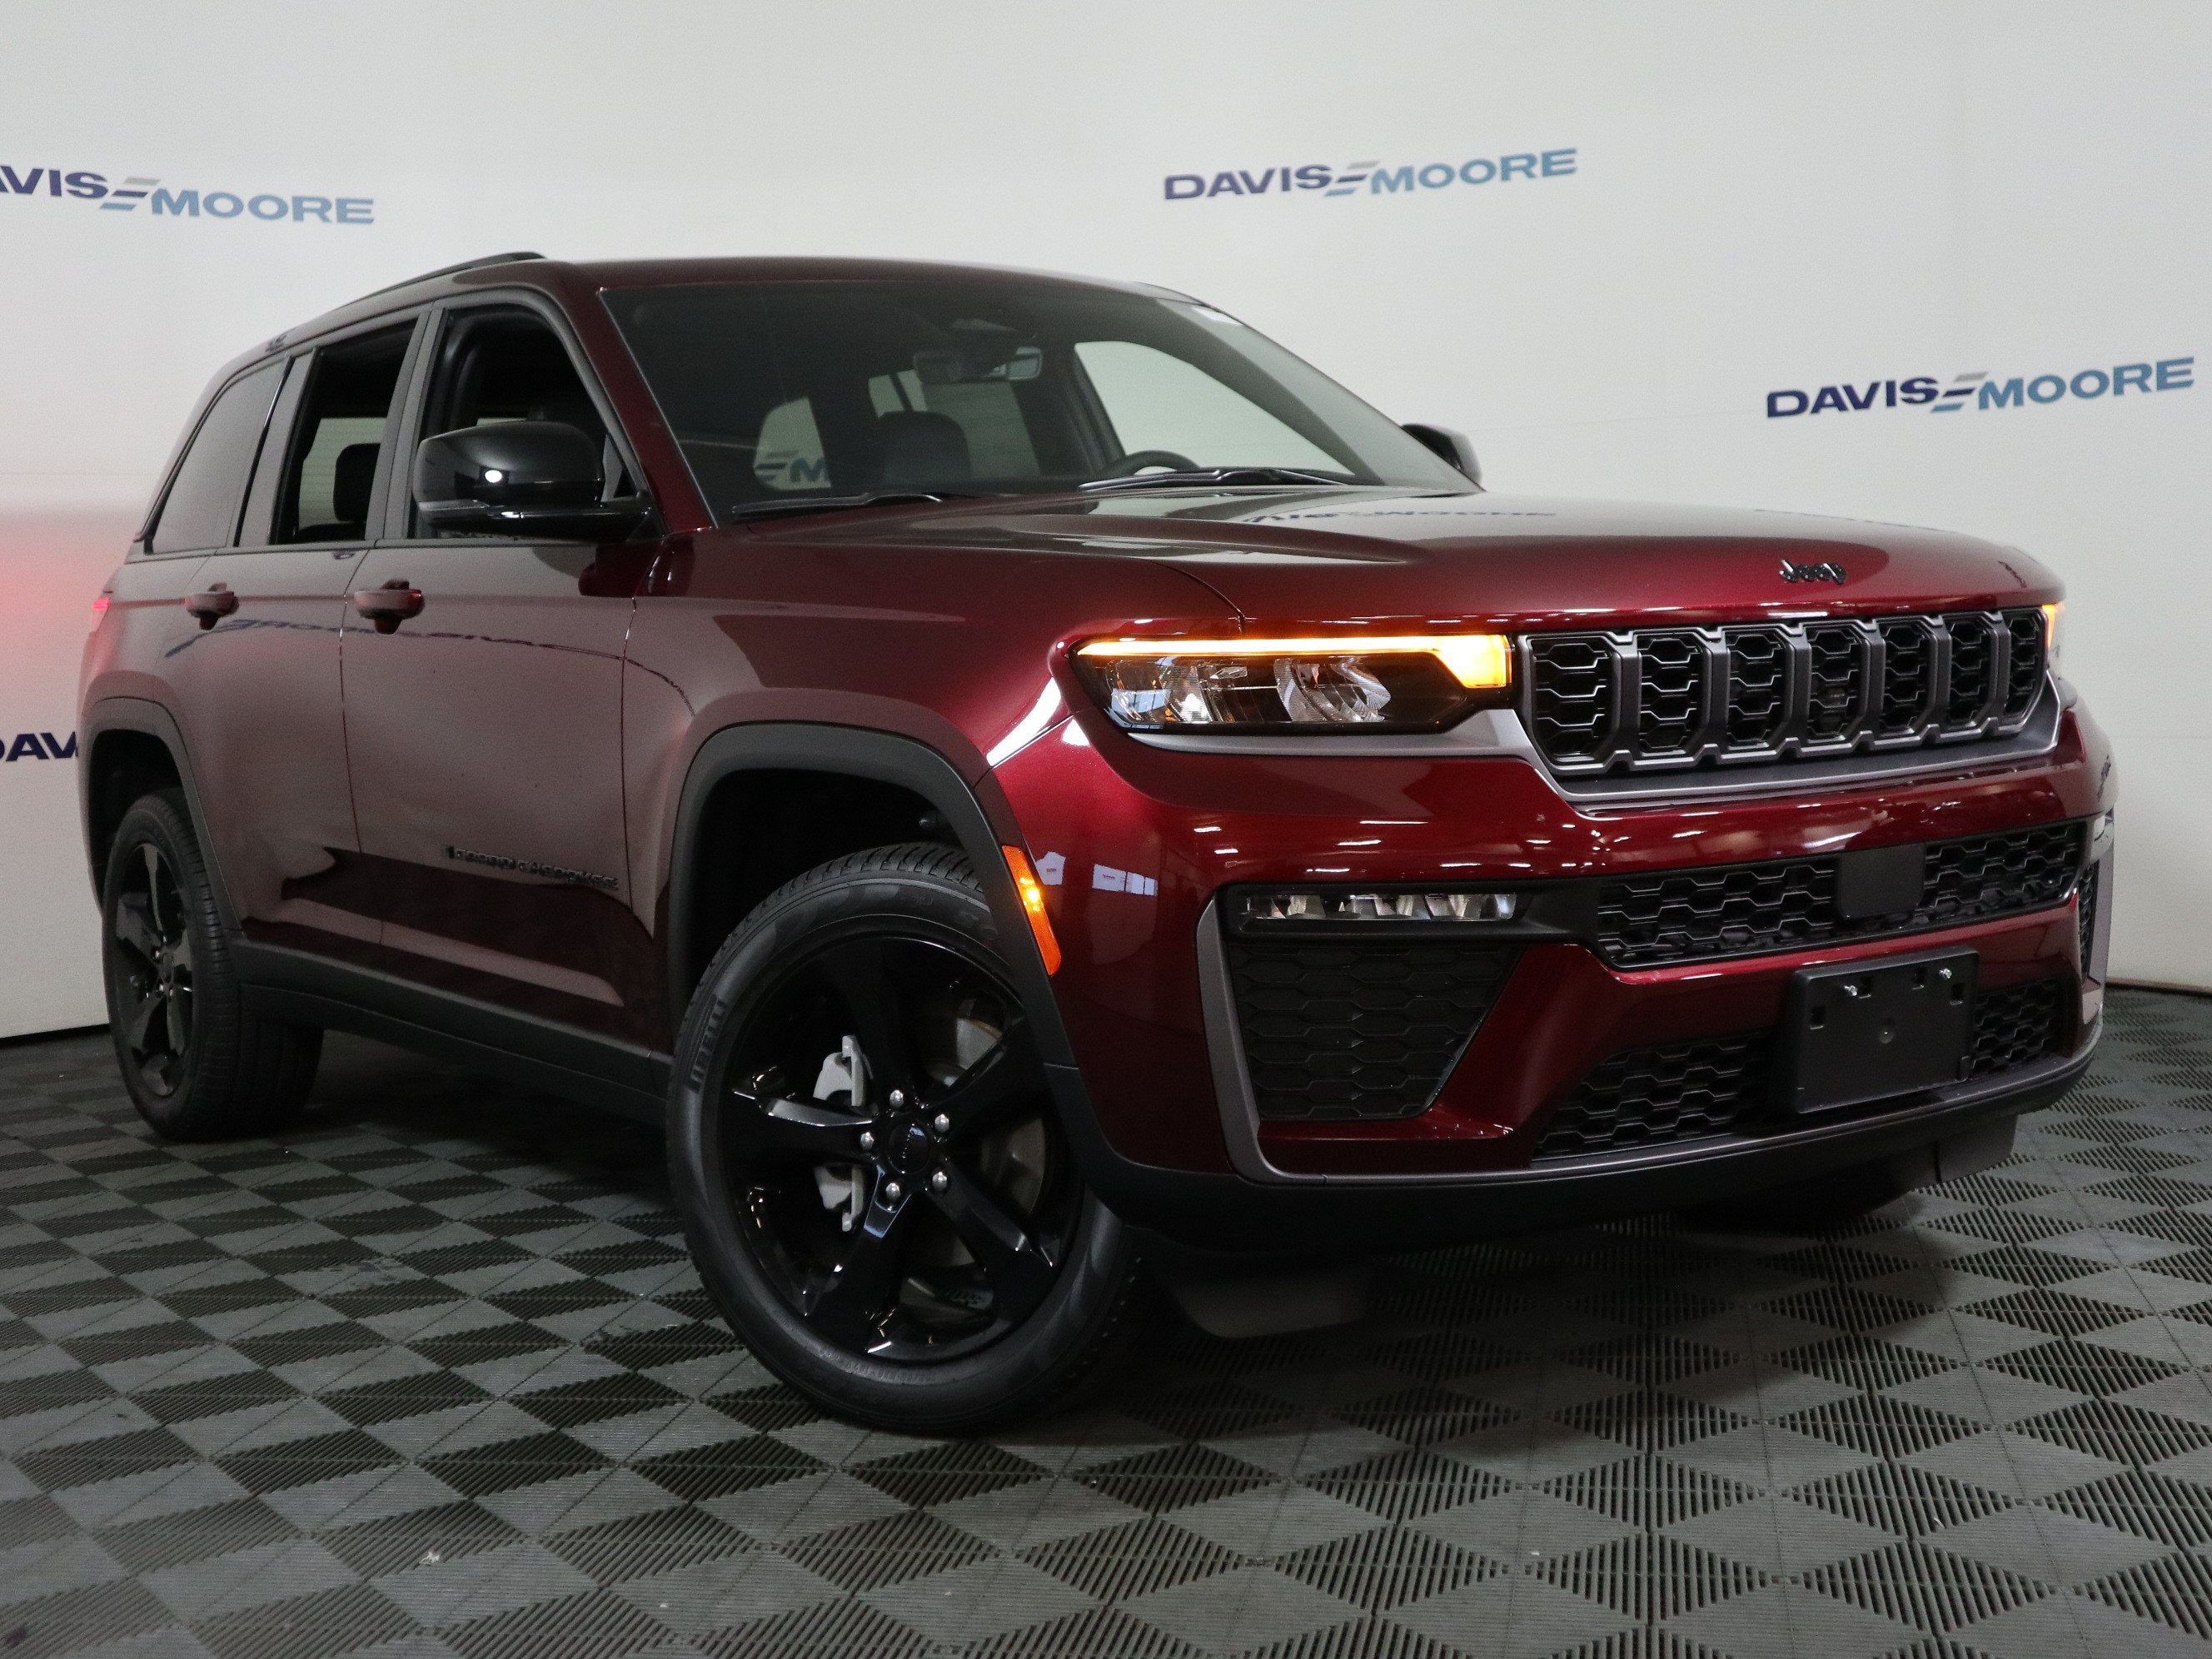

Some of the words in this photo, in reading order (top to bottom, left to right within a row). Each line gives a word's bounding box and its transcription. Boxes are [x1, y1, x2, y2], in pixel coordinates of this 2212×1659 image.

[0, 164, 109, 200] VIS
[152, 187, 373, 225] MOORE
[1164, 164, 1333, 201] DAVIS
[1371, 147, 1577, 194] MOORE
[1766, 376, 1940, 419] DAVIS
[1978, 356, 2195, 411] MOORE
[1779, 559, 1847, 585] Jeep
